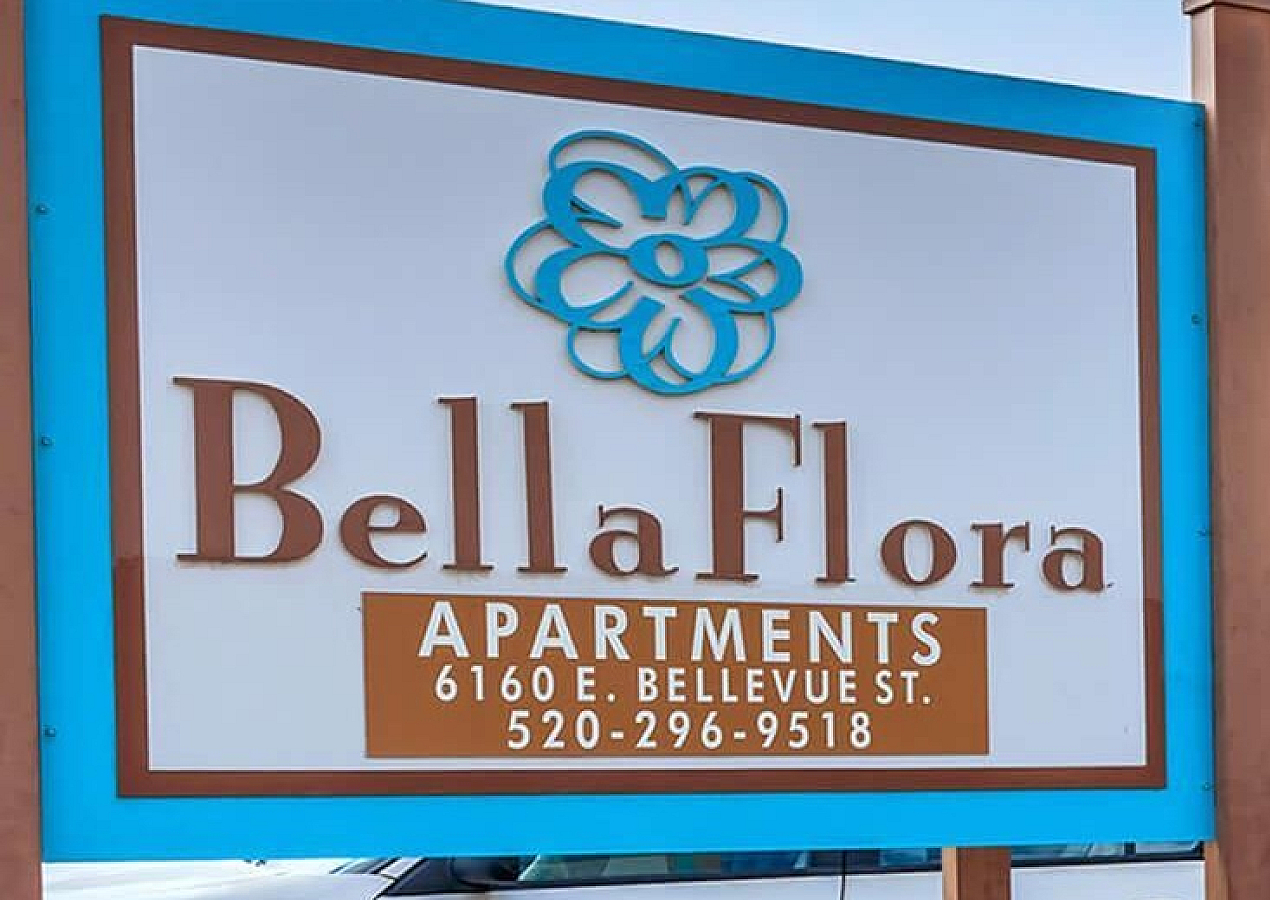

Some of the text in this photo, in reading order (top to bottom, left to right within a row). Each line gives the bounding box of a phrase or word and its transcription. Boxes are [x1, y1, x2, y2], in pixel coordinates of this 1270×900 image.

[173, 375, 1114, 592] Bella Flora
[418, 601, 942, 667] APARTMENTS
[434, 665, 931, 705] 6160 E. BELLEVUE ST.
[507, 709, 872, 749] 520-296-9518
